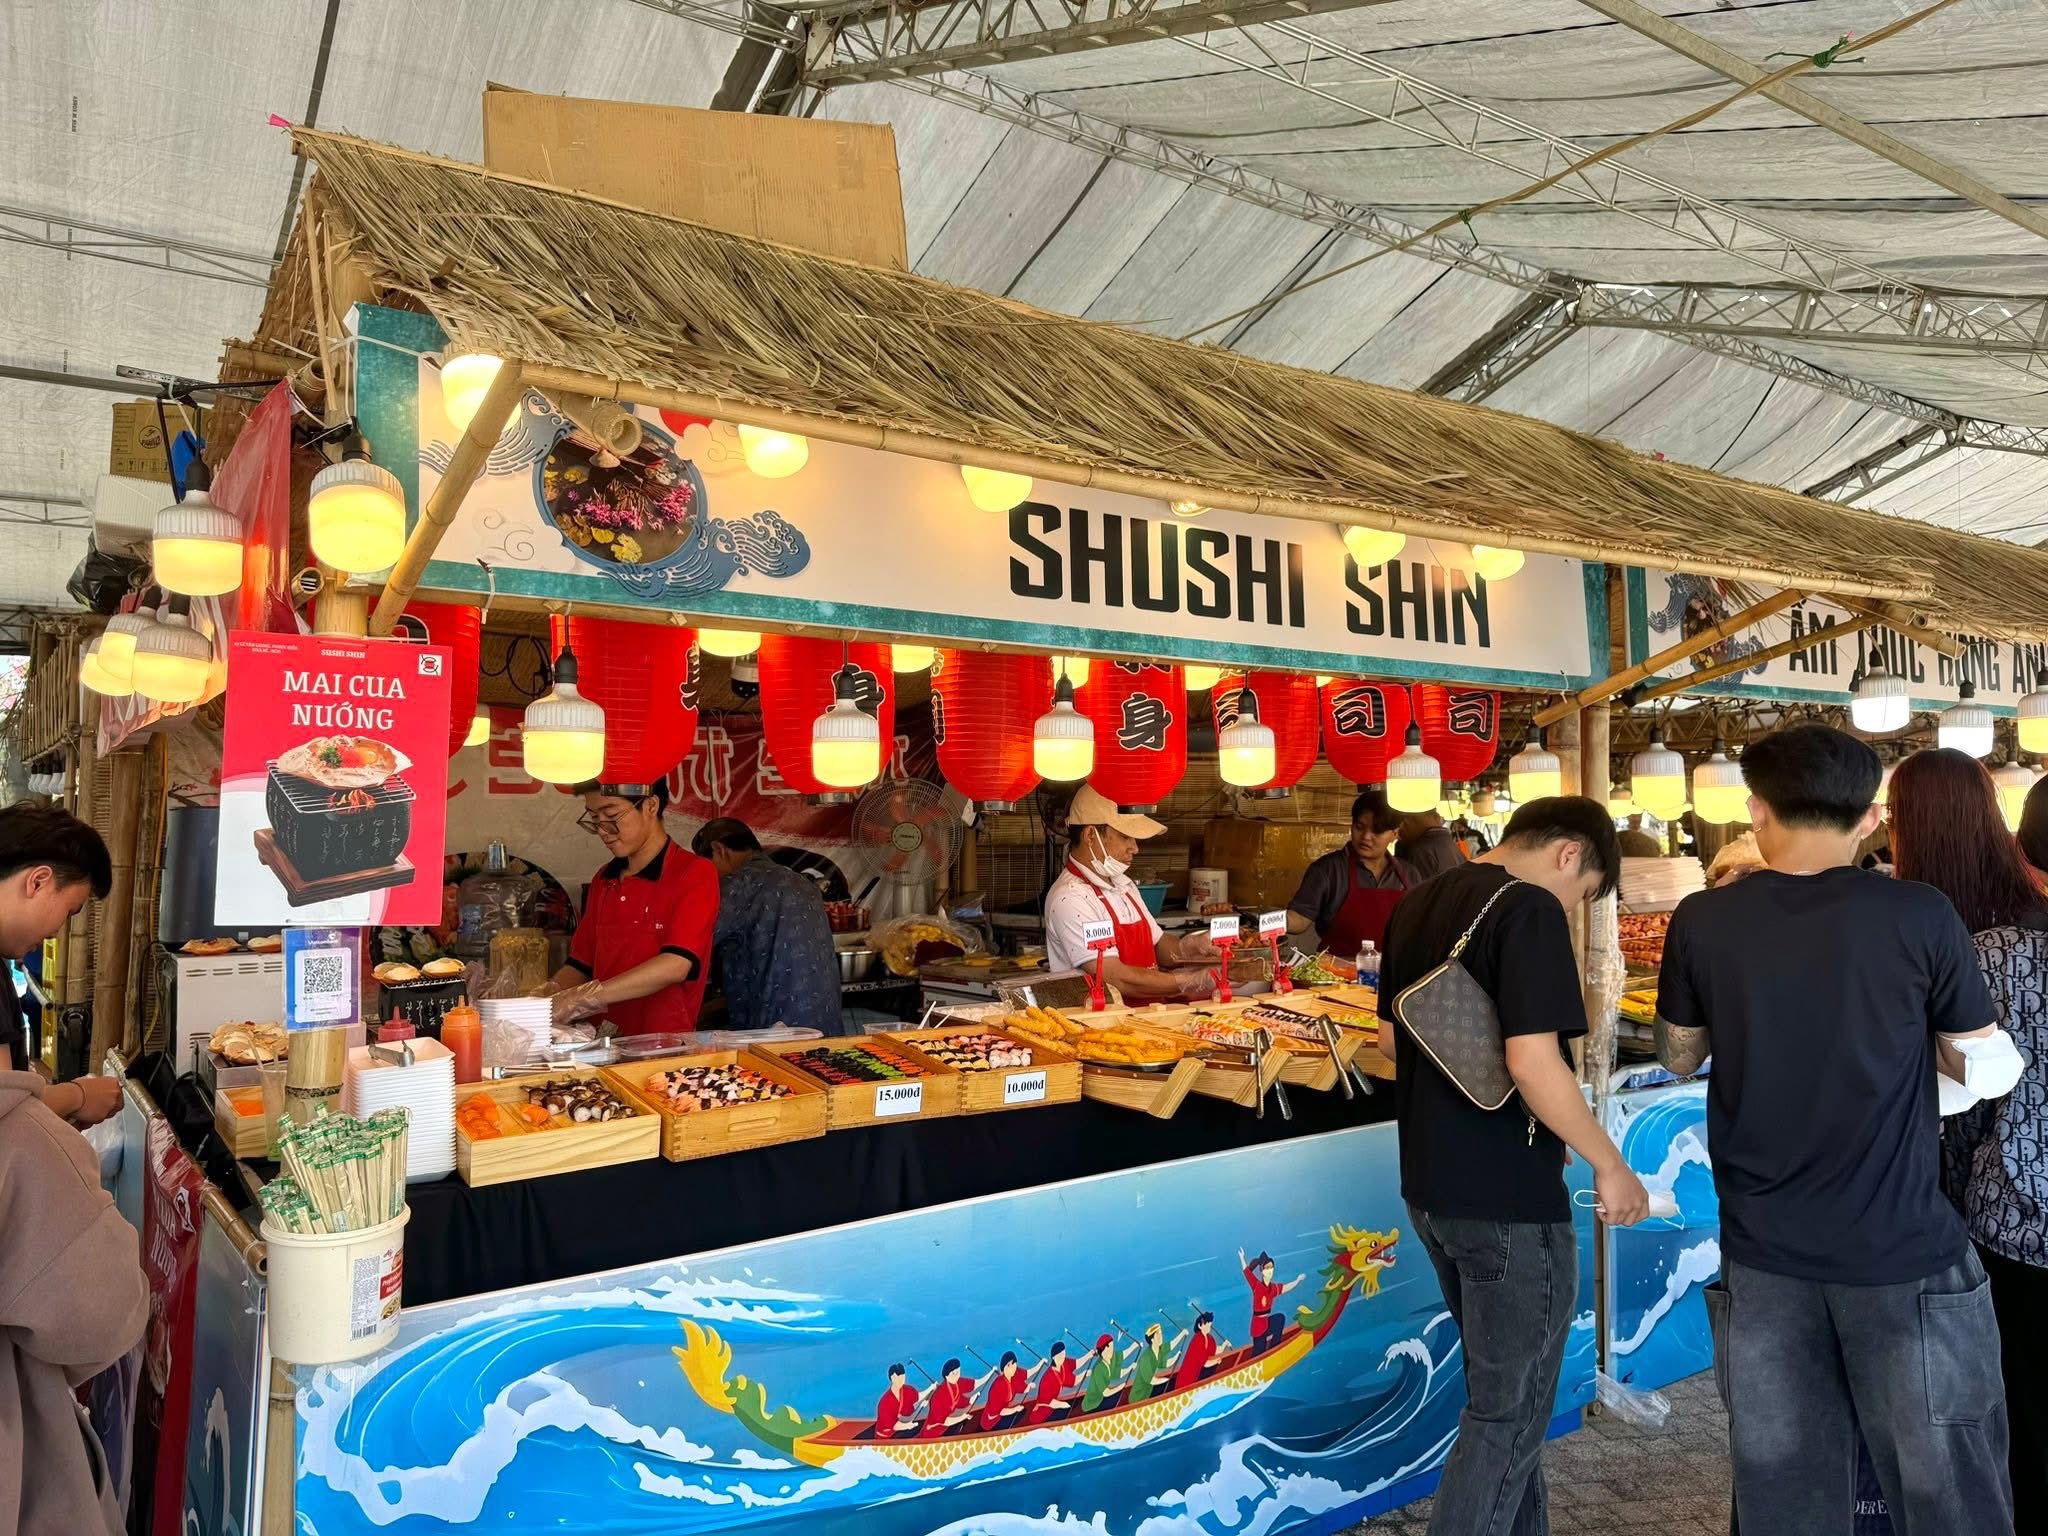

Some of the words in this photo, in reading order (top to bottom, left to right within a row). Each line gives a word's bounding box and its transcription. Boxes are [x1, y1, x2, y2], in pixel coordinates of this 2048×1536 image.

[1008, 502, 1305, 628] SHUSHI
[1344, 552, 1491, 648] SHIN
[282, 670, 342, 695] MAI
[349, 675, 406, 699] CUA
[291, 701, 395, 730] NƯỚNG
